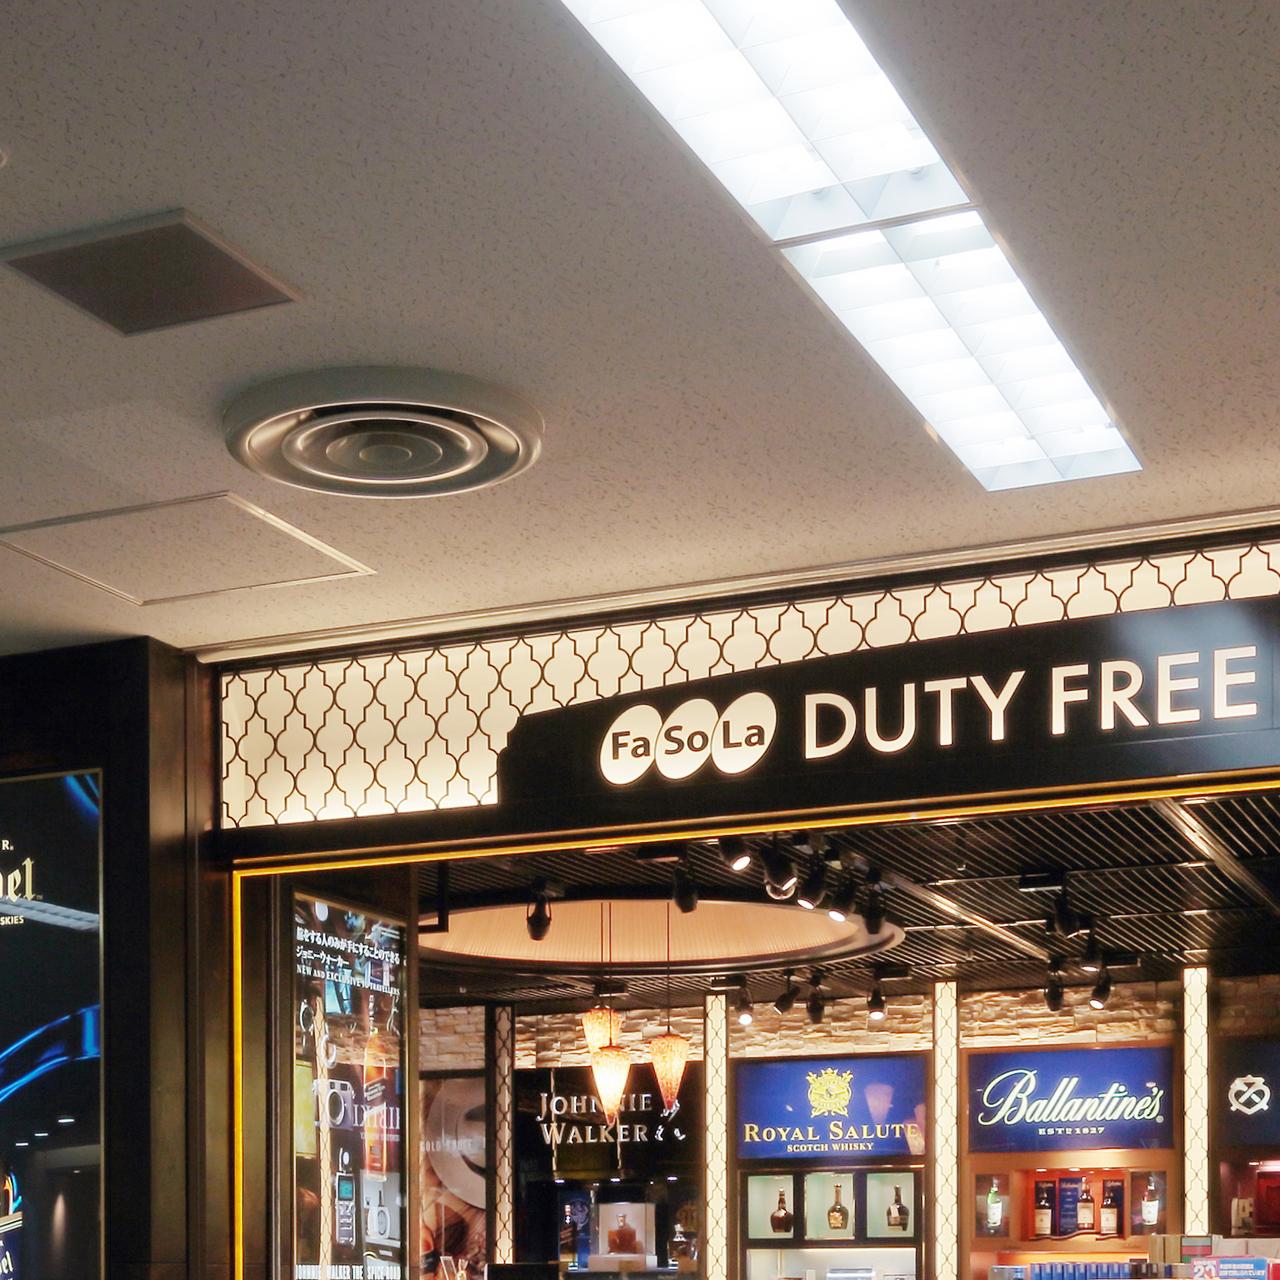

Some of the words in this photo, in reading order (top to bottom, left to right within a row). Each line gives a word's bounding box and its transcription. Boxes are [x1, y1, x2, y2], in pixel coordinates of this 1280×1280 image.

[805, 670, 1025, 760] DUTY
[1051, 644, 1258, 736] FREE
[977, 1069, 1163, 1127] Ballantine's
[539, 1122, 649, 1145] WALKER
[744, 1122, 820, 1142] ROYAL
[828, 1119, 921, 1141] SALUTE
[786, 1143, 829, 1152] SCOTCH
[831, 1142, 875, 1151] WHISKY
